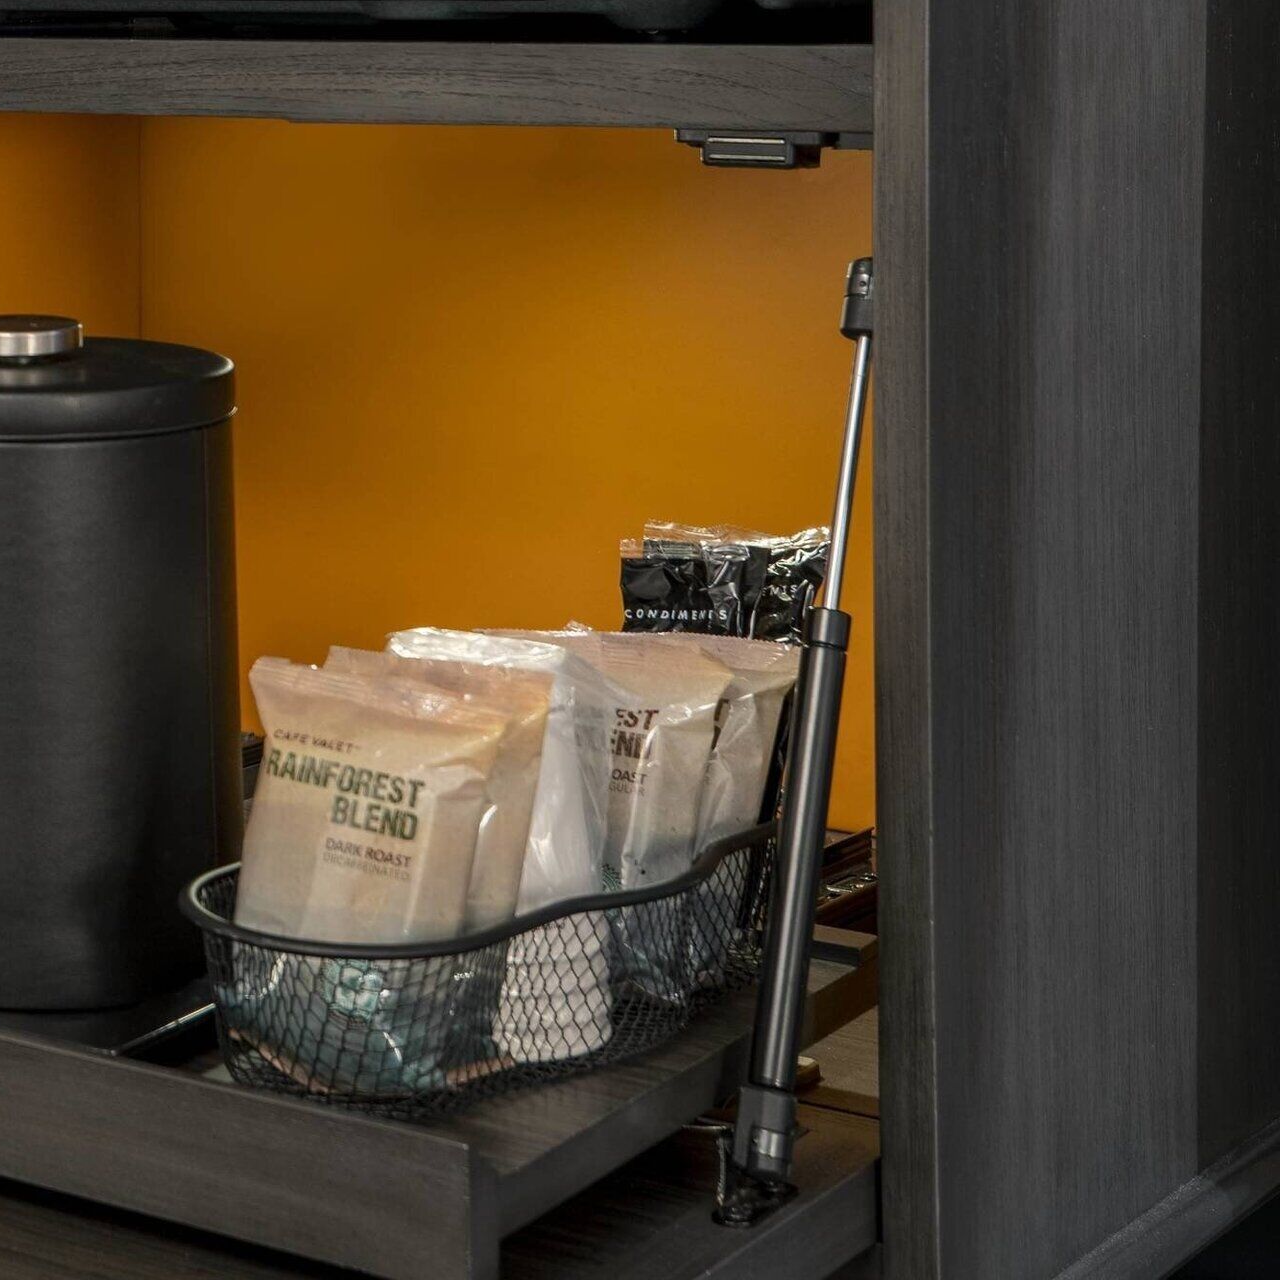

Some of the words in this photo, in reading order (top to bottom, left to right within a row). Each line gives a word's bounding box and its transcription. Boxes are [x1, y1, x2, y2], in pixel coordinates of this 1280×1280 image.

[266, 747, 426, 808] RAINFOREST
[331, 794, 418, 840] BLEND
[325, 837, 362, 856] DARK
[364, 846, 412, 867] ROAST
